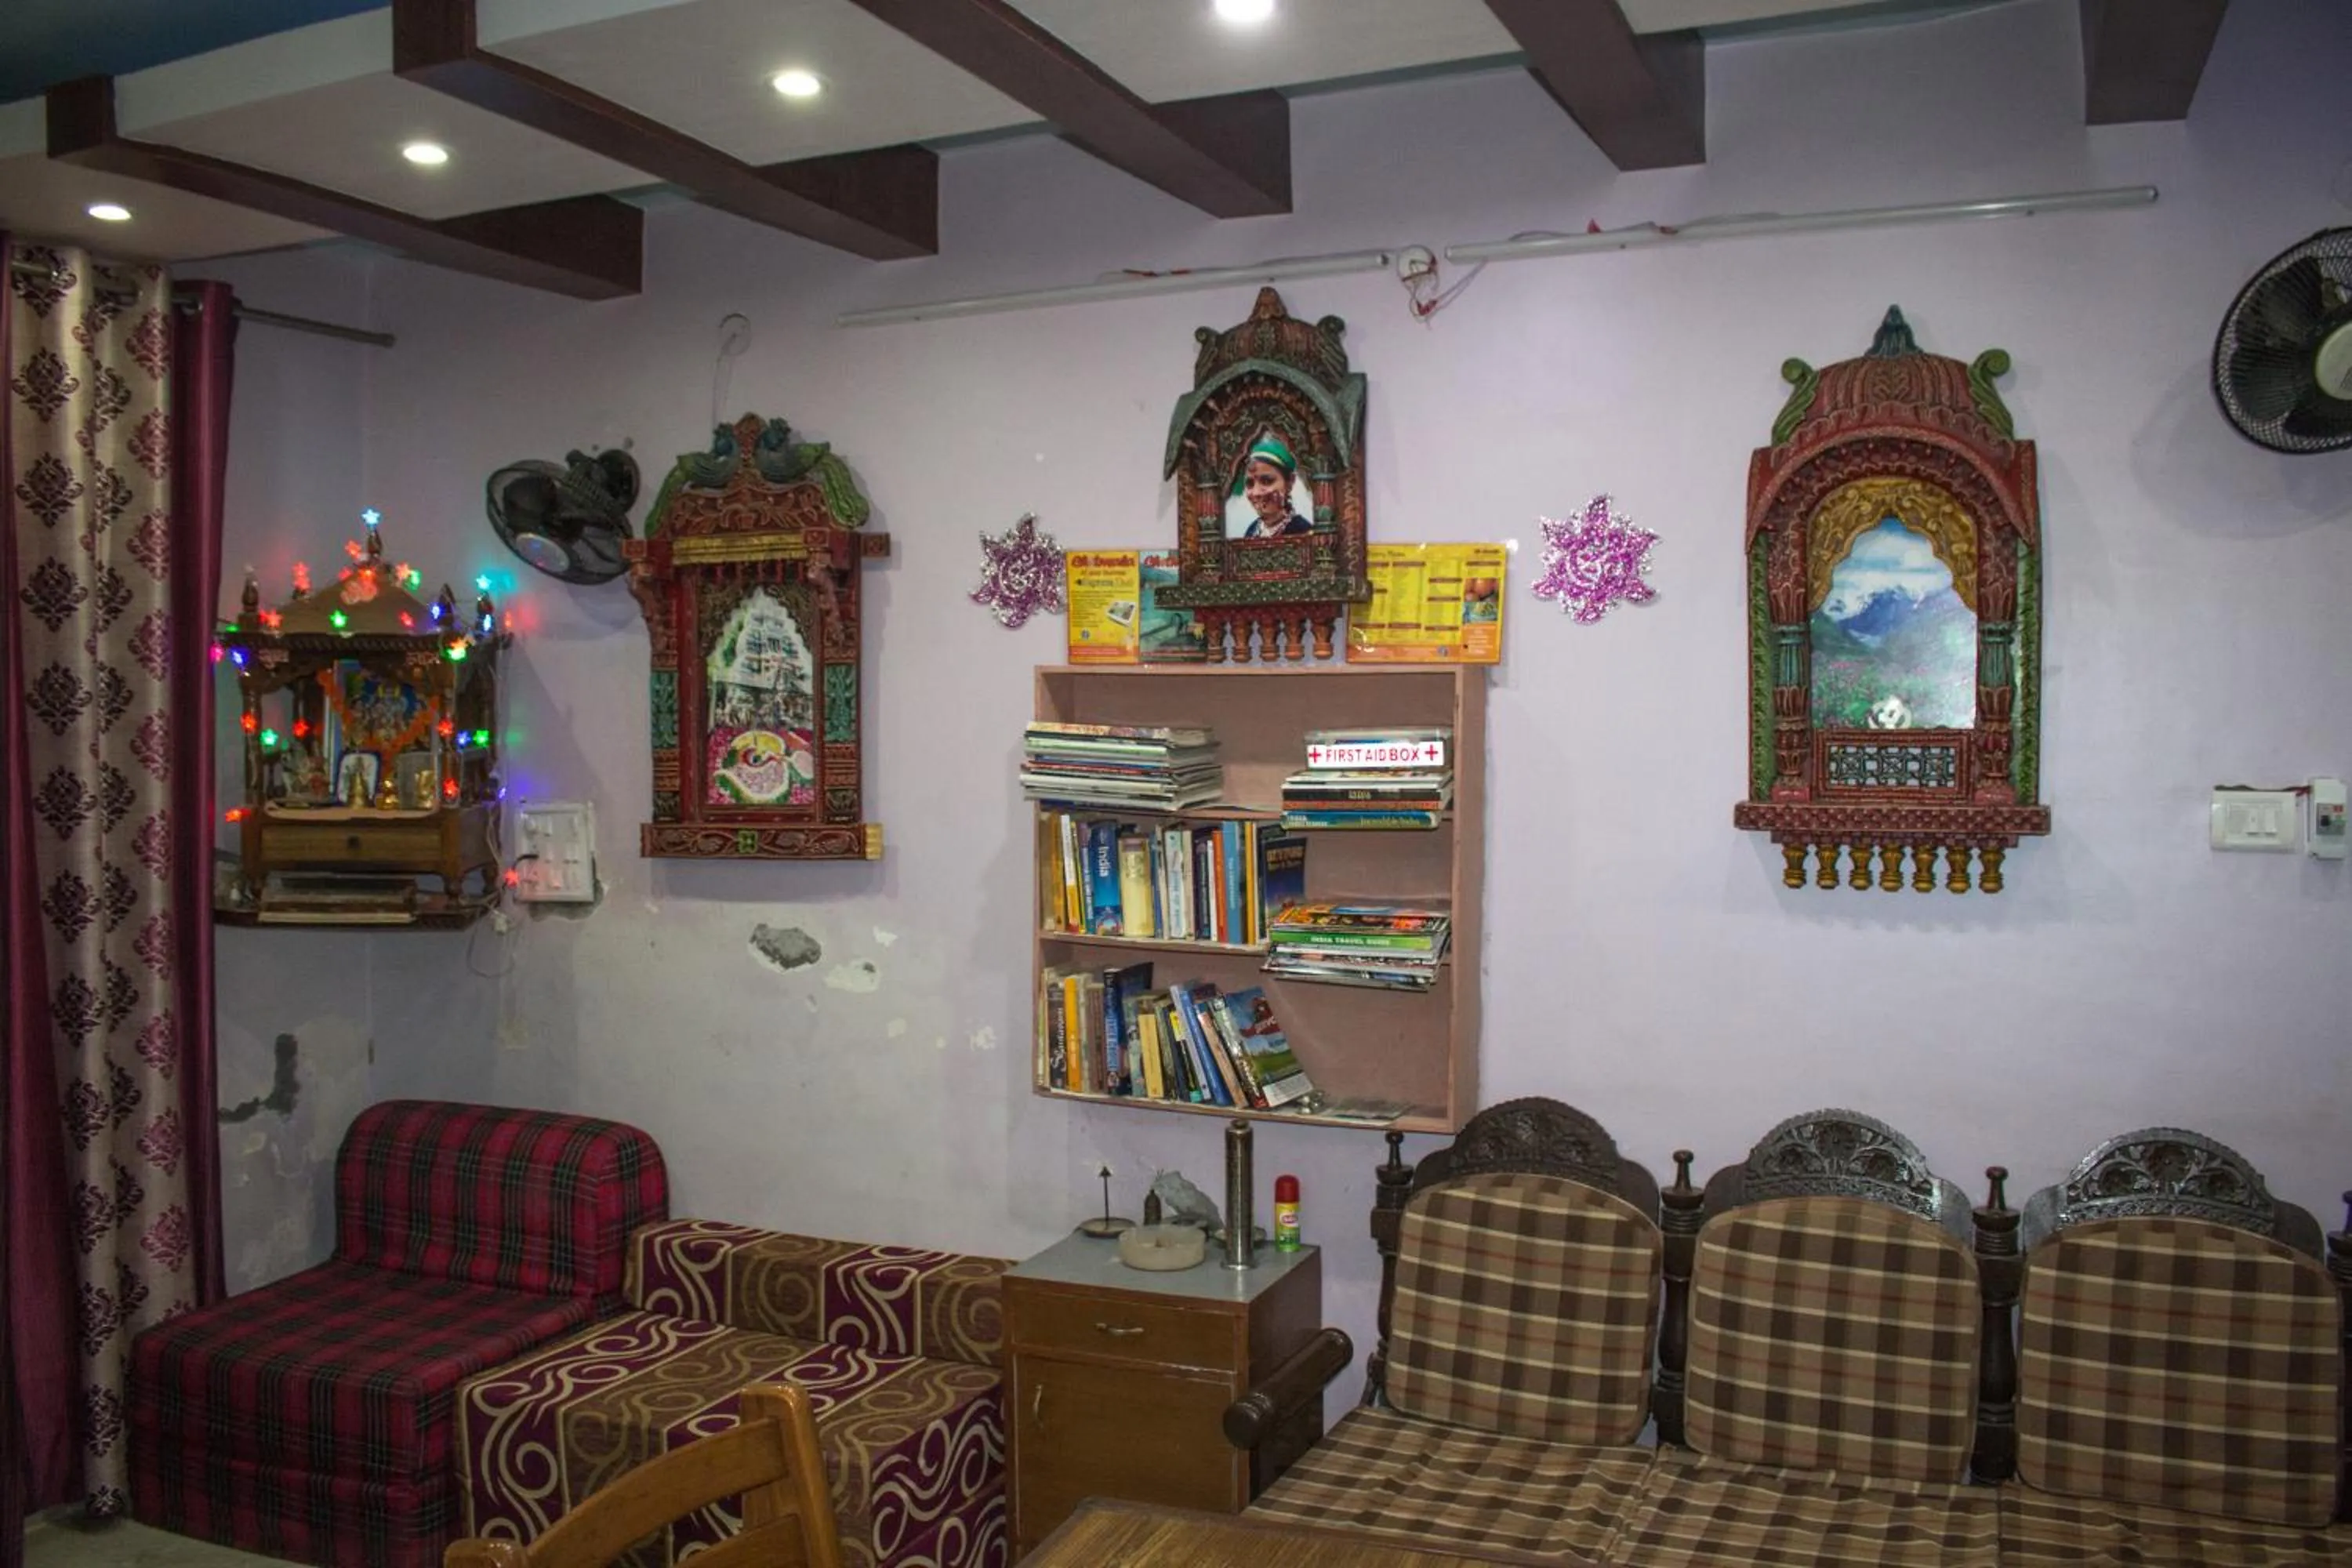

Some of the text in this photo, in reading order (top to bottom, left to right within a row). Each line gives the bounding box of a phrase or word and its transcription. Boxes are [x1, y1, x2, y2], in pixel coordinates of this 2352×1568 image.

[1326, 746, 1420, 763] FIRST AID BOX
[1098, 846, 1112, 877] India
